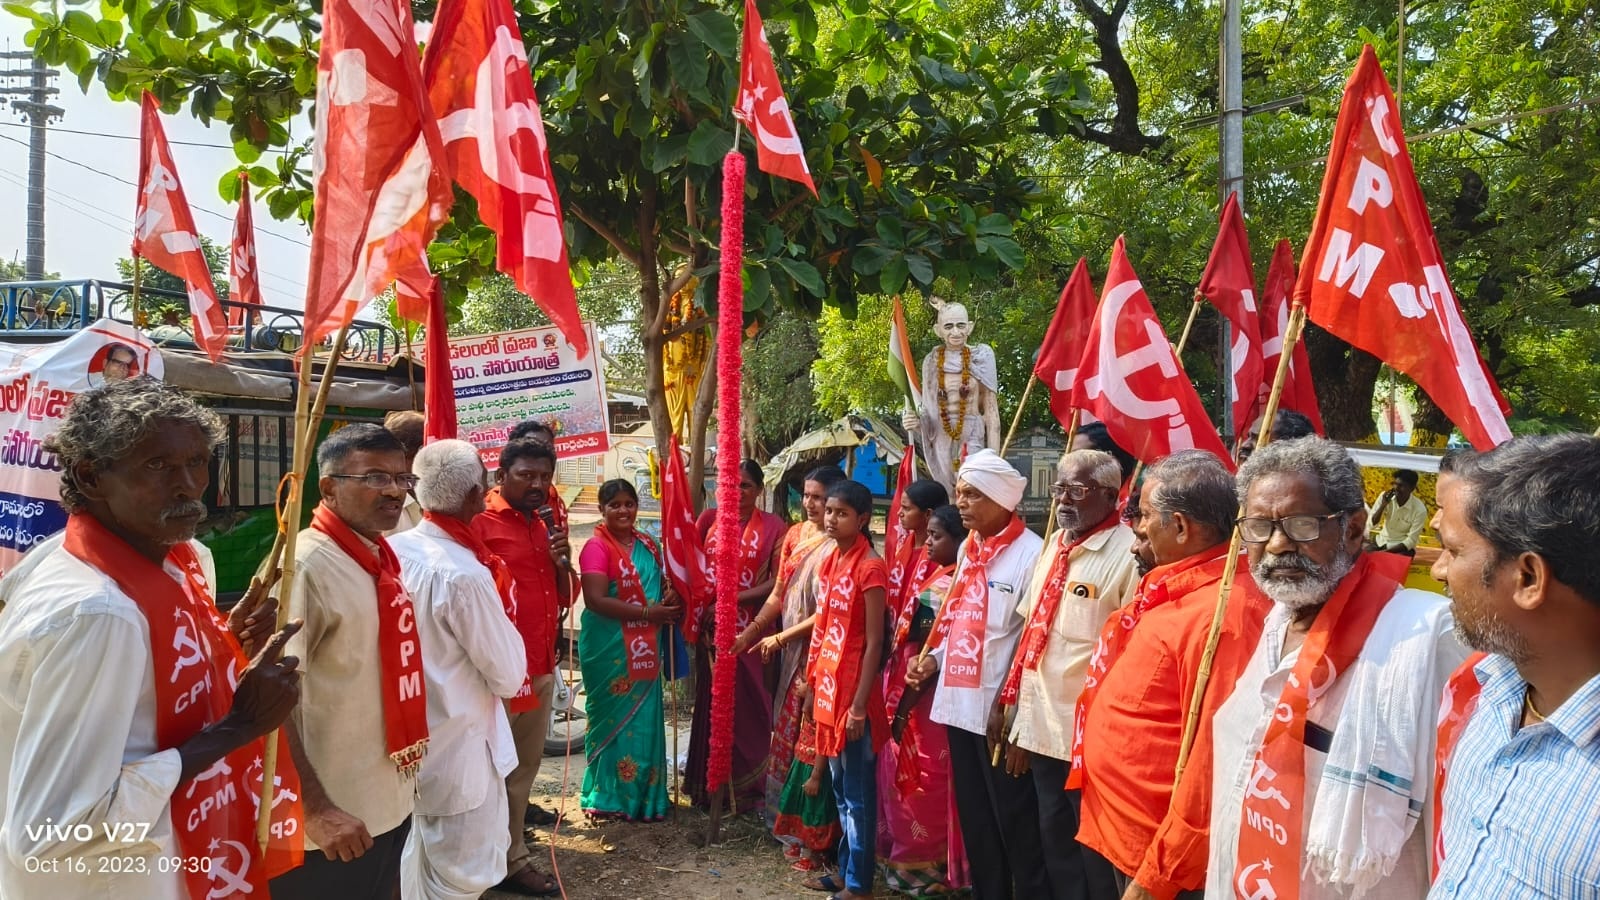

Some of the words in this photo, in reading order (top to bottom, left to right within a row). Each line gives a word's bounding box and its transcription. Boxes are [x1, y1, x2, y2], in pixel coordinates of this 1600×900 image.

[829, 598, 849, 612] CPM
[954, 610, 983, 621] CPM
[821, 648, 839, 663] CPM
[949, 665, 978, 676] CPM
[818, 698, 832, 712] CPM
[186, 781, 237, 833] CPM
